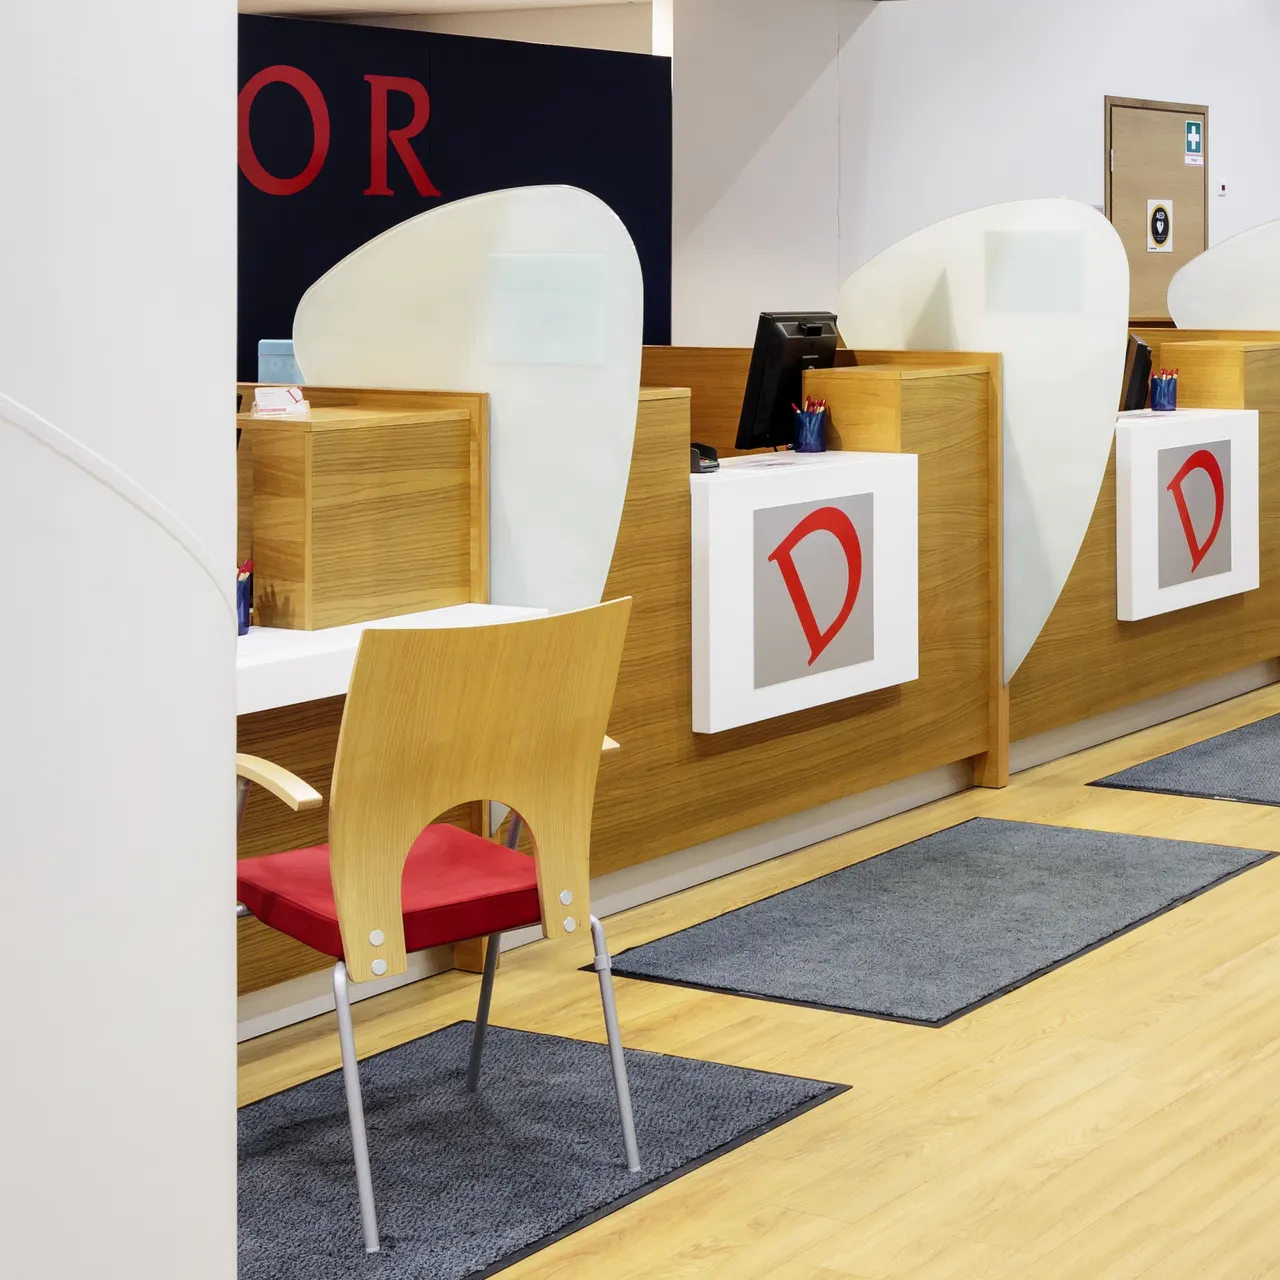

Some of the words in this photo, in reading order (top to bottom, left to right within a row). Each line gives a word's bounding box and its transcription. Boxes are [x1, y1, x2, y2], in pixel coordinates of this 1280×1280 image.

[1155, 211, 1165, 219] AED
[1166, 449, 1225, 574] D
[767, 505, 864, 668] D
